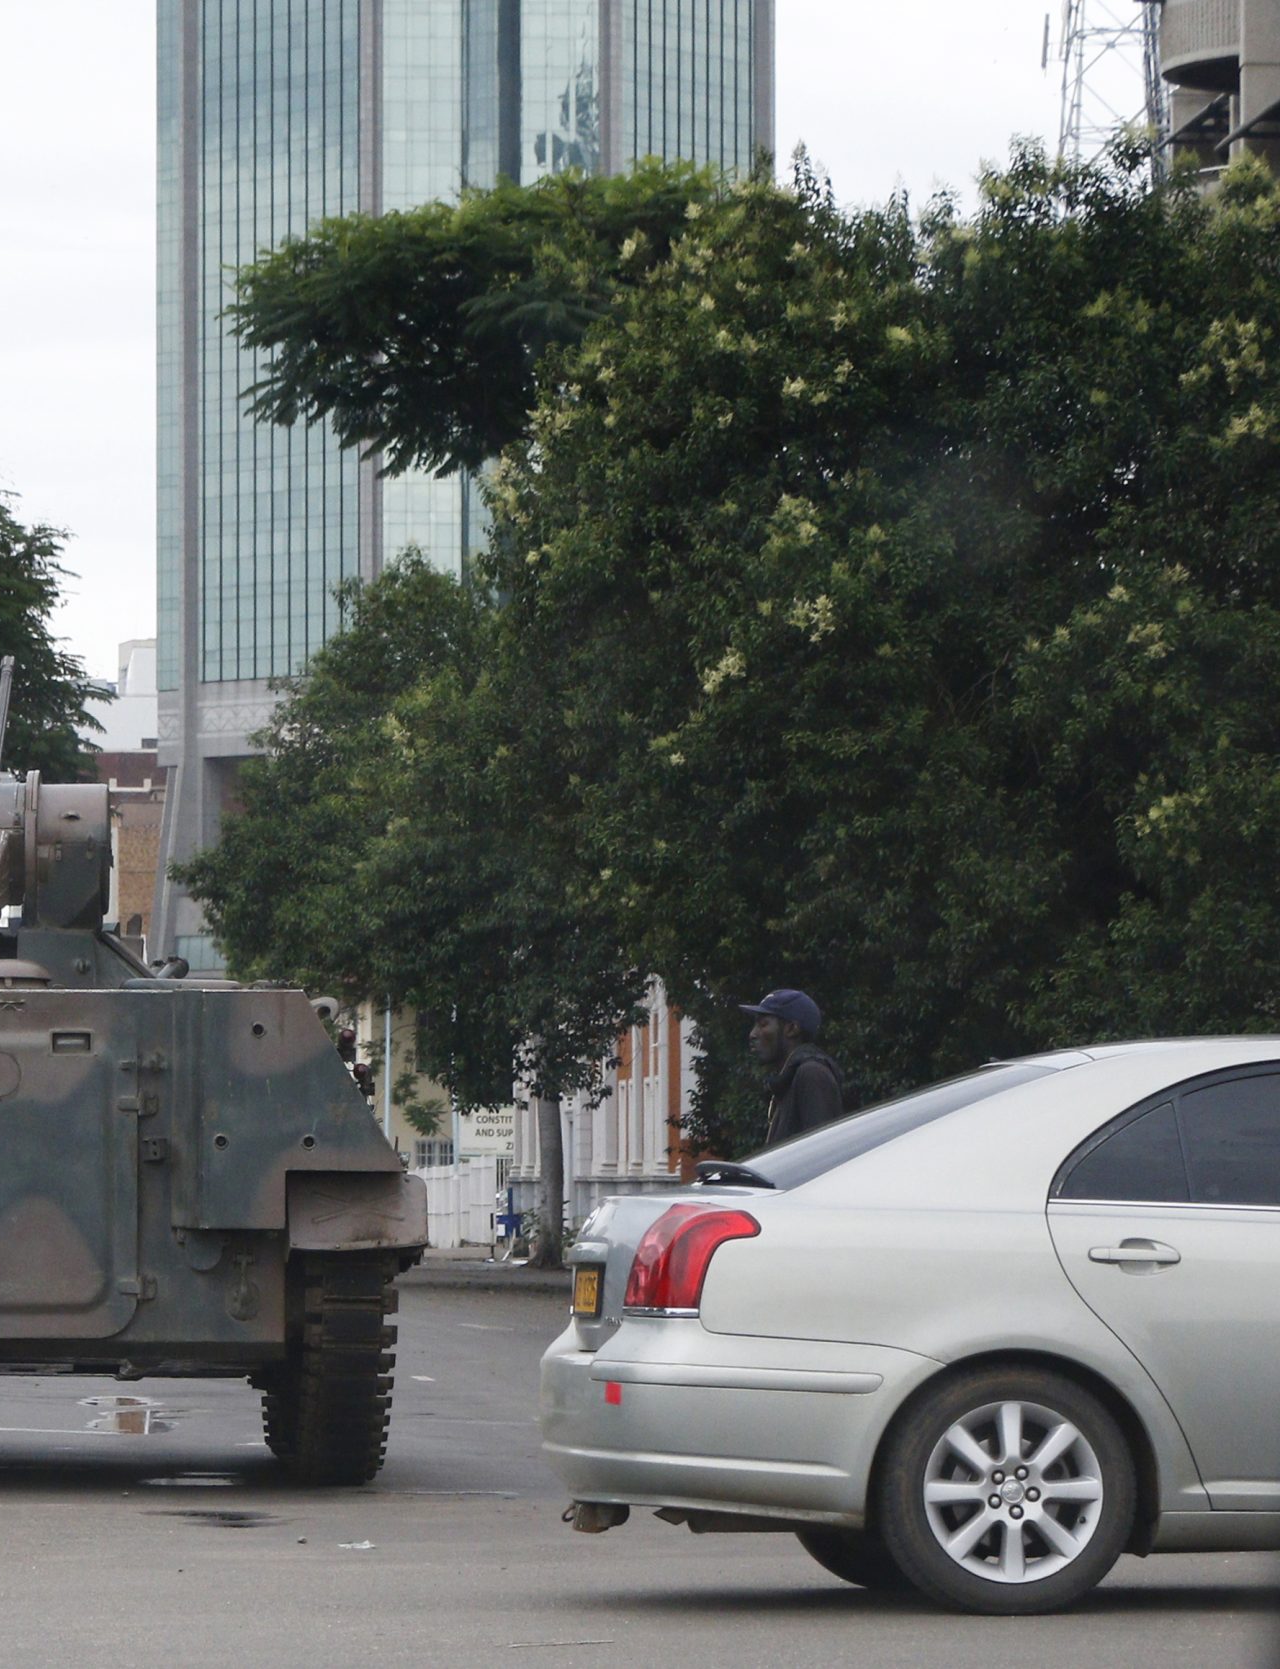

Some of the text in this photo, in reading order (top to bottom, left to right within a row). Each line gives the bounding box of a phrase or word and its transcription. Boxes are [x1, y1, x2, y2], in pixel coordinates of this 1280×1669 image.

[476, 1115, 513, 1124] CONSTIT
[475, 1128, 514, 1137] AND SUP
